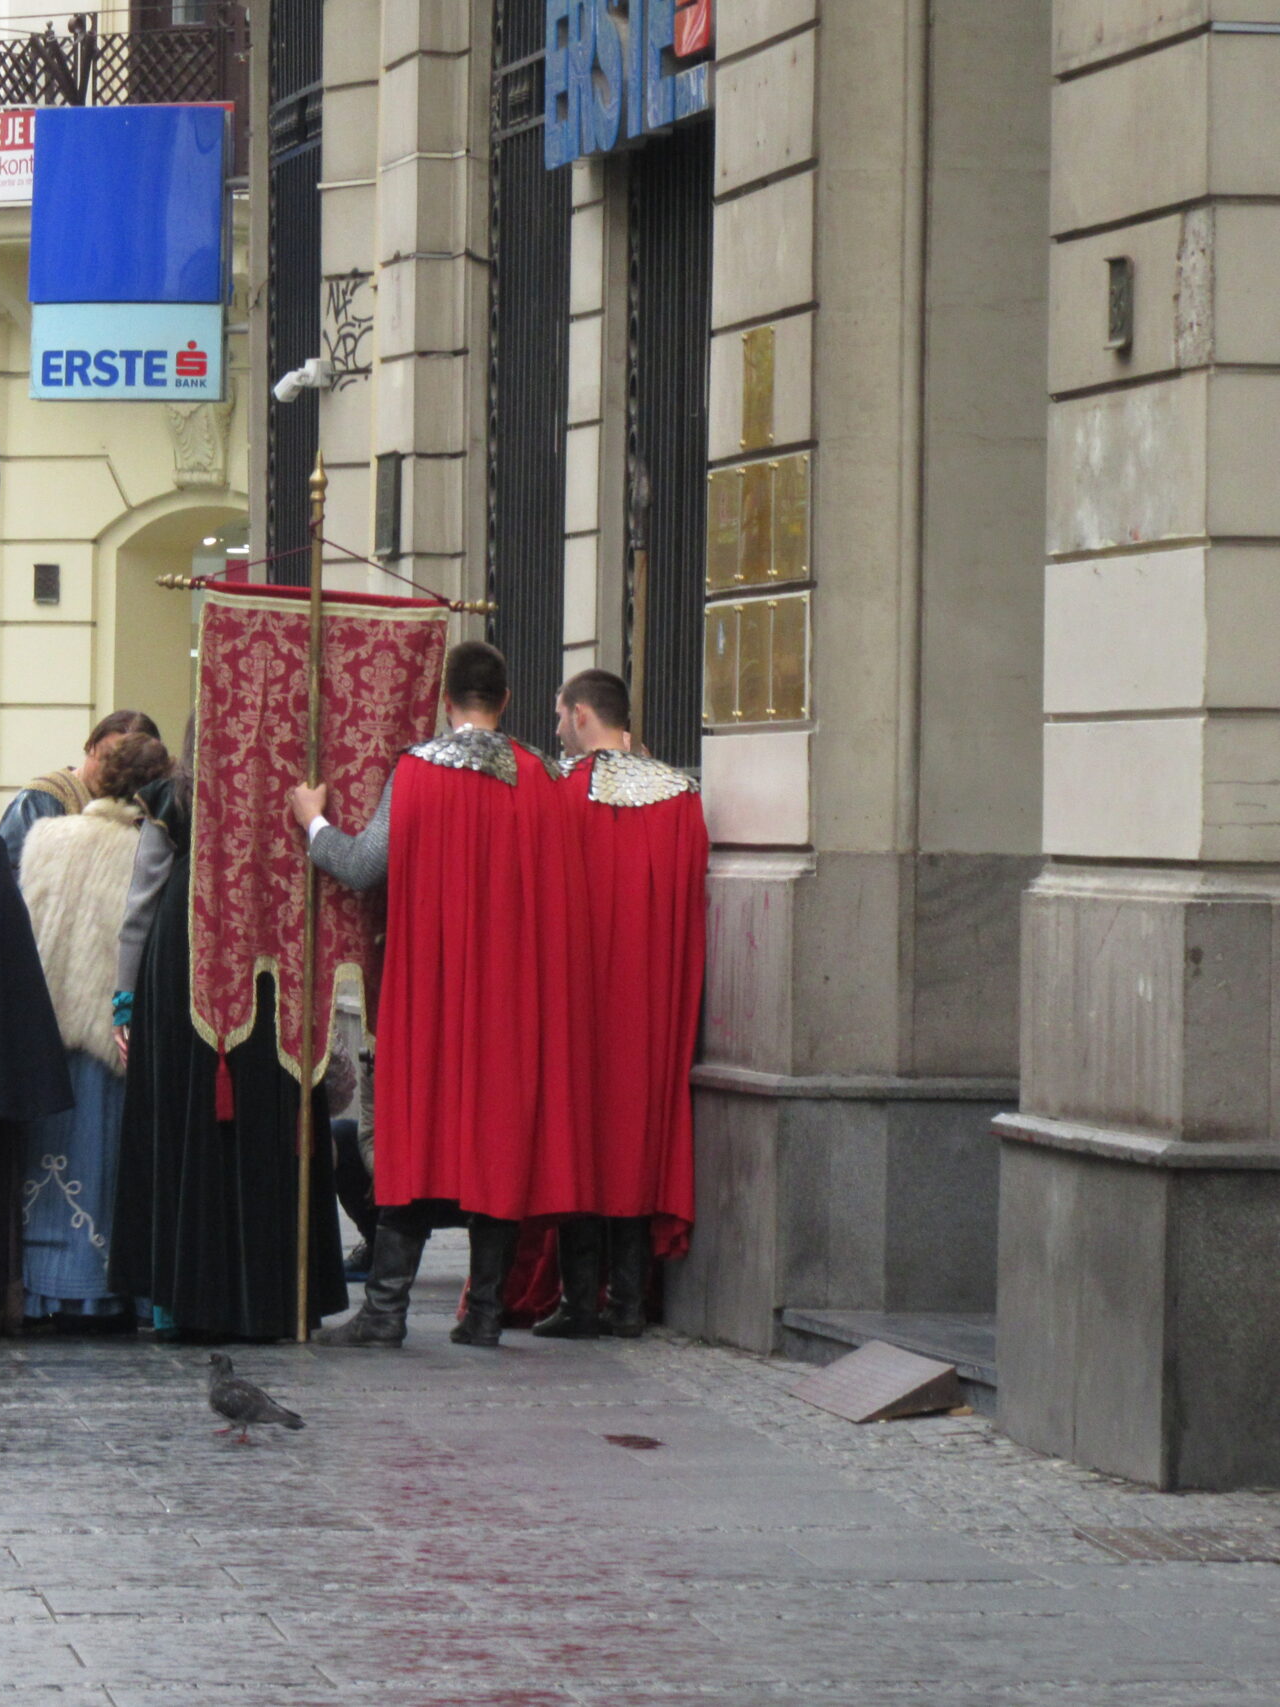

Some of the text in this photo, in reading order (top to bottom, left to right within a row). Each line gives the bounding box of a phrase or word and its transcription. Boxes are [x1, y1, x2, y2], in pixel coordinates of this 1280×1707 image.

[5, 117, 24, 145] JE
[42, 350, 168, 387] ERSTE
[175, 379, 207, 388] BANK
